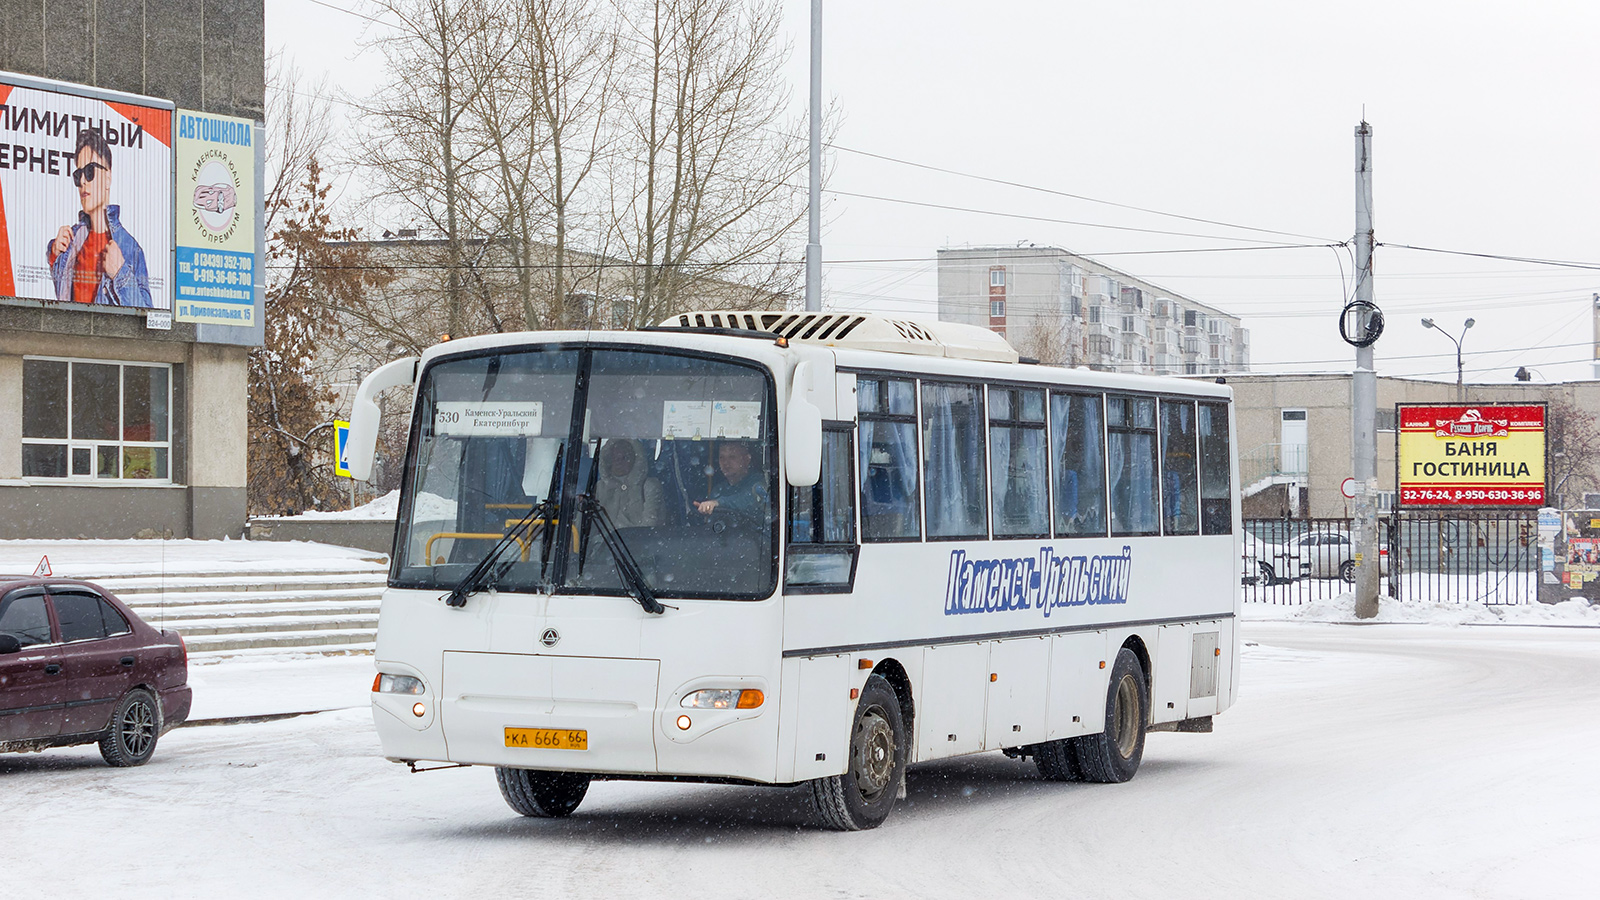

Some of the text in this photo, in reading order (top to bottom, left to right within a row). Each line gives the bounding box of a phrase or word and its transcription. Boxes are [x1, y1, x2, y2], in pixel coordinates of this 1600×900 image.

[179, 114, 252, 147] АВТОШКОЛА
[191, 149, 228, 182] КАМЕНСКАЯ
[191, 208, 241, 243] АВТОПРЕМИУМ
[194, 252, 252, 271] 8 (3439) 352-700
[194, 268, 252, 286] 8-919-36-06-700
[179, 305, 189, 317] ул.
[244, 308, 251, 320] 15
[147, 319, 170, 329] 324-000
[438, 411, 460, 424] 530
[464, 408, 537, 419] Каменск-Уральский
[473, 419, 530, 429] Екатеринбург
[1445, 442, 1497, 456] БАНЯ
[1413, 462, 1531, 478] ГОСТИНИЦА
[1403, 490, 1542, 500] 32-76-24, 8-950-630-36-96
[945, 546, 1131, 617] Каменск-Уральский
[534, 731, 560, 746] 666
[568, 732, 582, 742] 66
